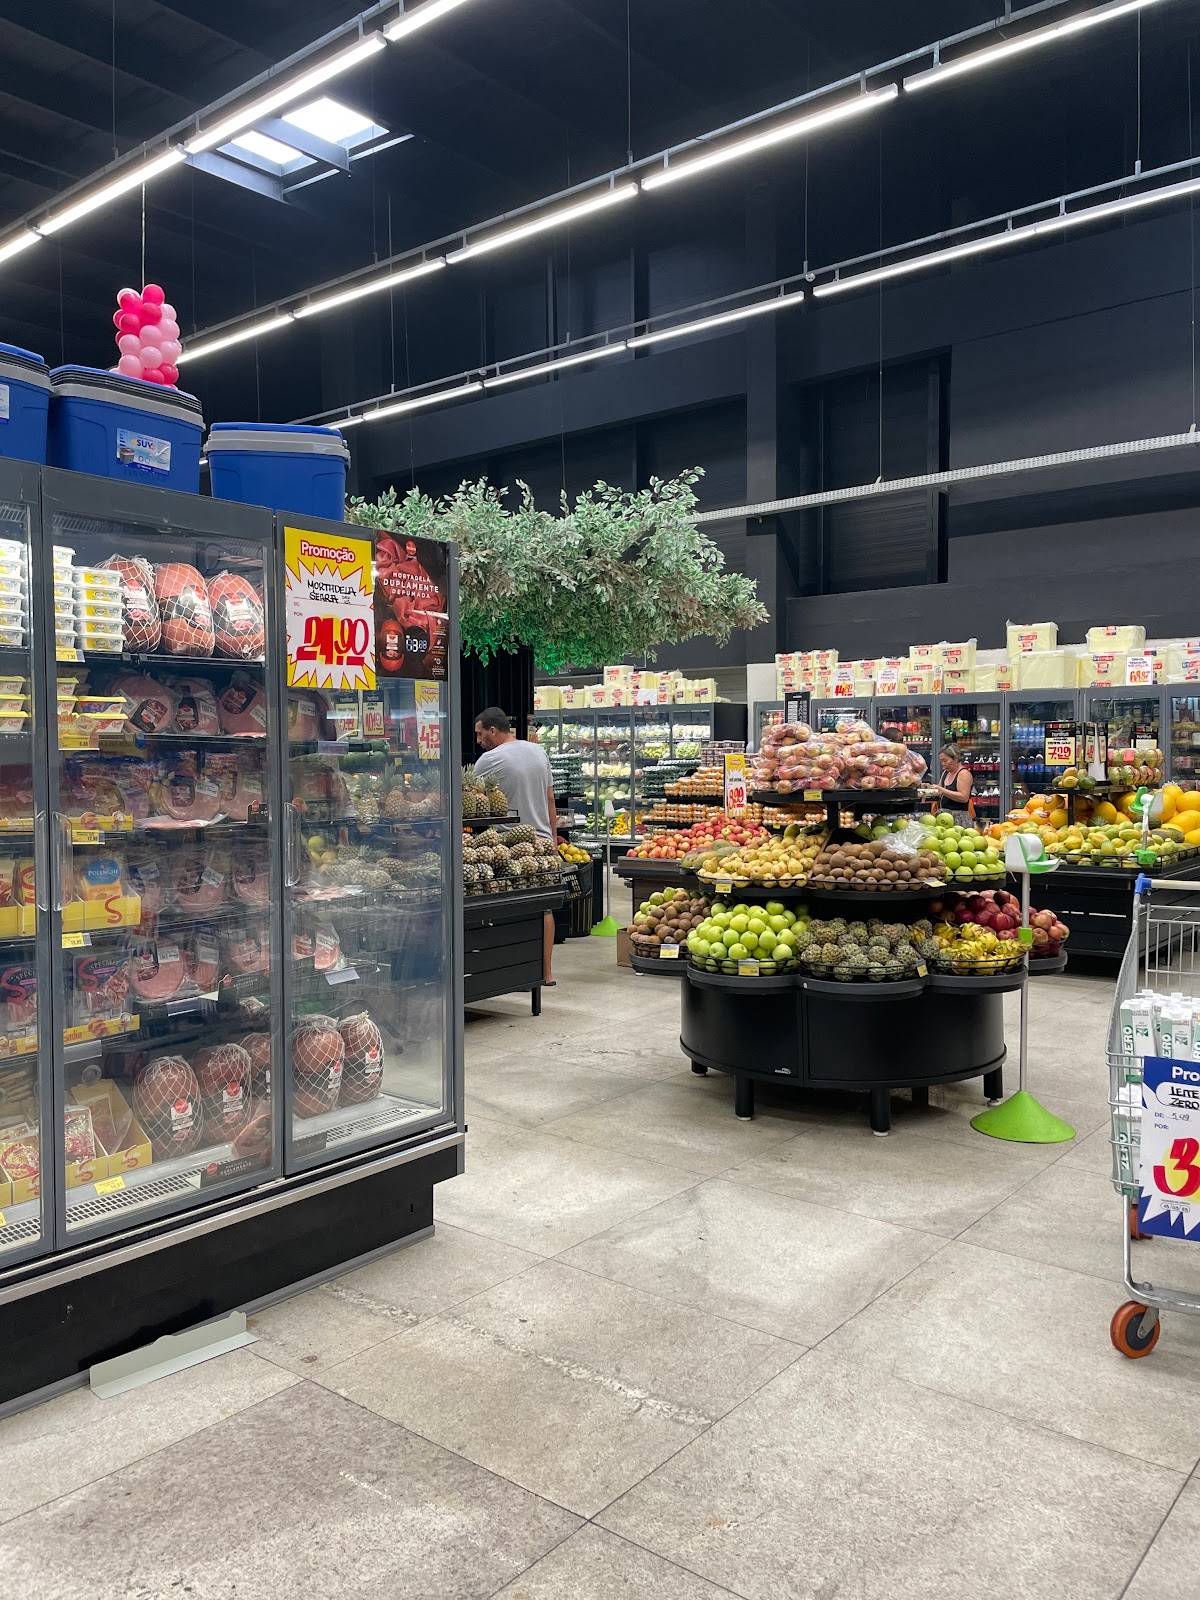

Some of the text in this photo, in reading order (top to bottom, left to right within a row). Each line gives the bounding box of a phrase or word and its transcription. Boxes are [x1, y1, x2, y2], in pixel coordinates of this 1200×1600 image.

[301, 541, 355, 562] Promoção
[393, 572, 430, 583] MORTADELA
[383, 579, 439, 593] DUPLAMENTE
[392, 588, 431, 599] DEFUMADA
[1169, 1097, 1200, 1110] ZERO
